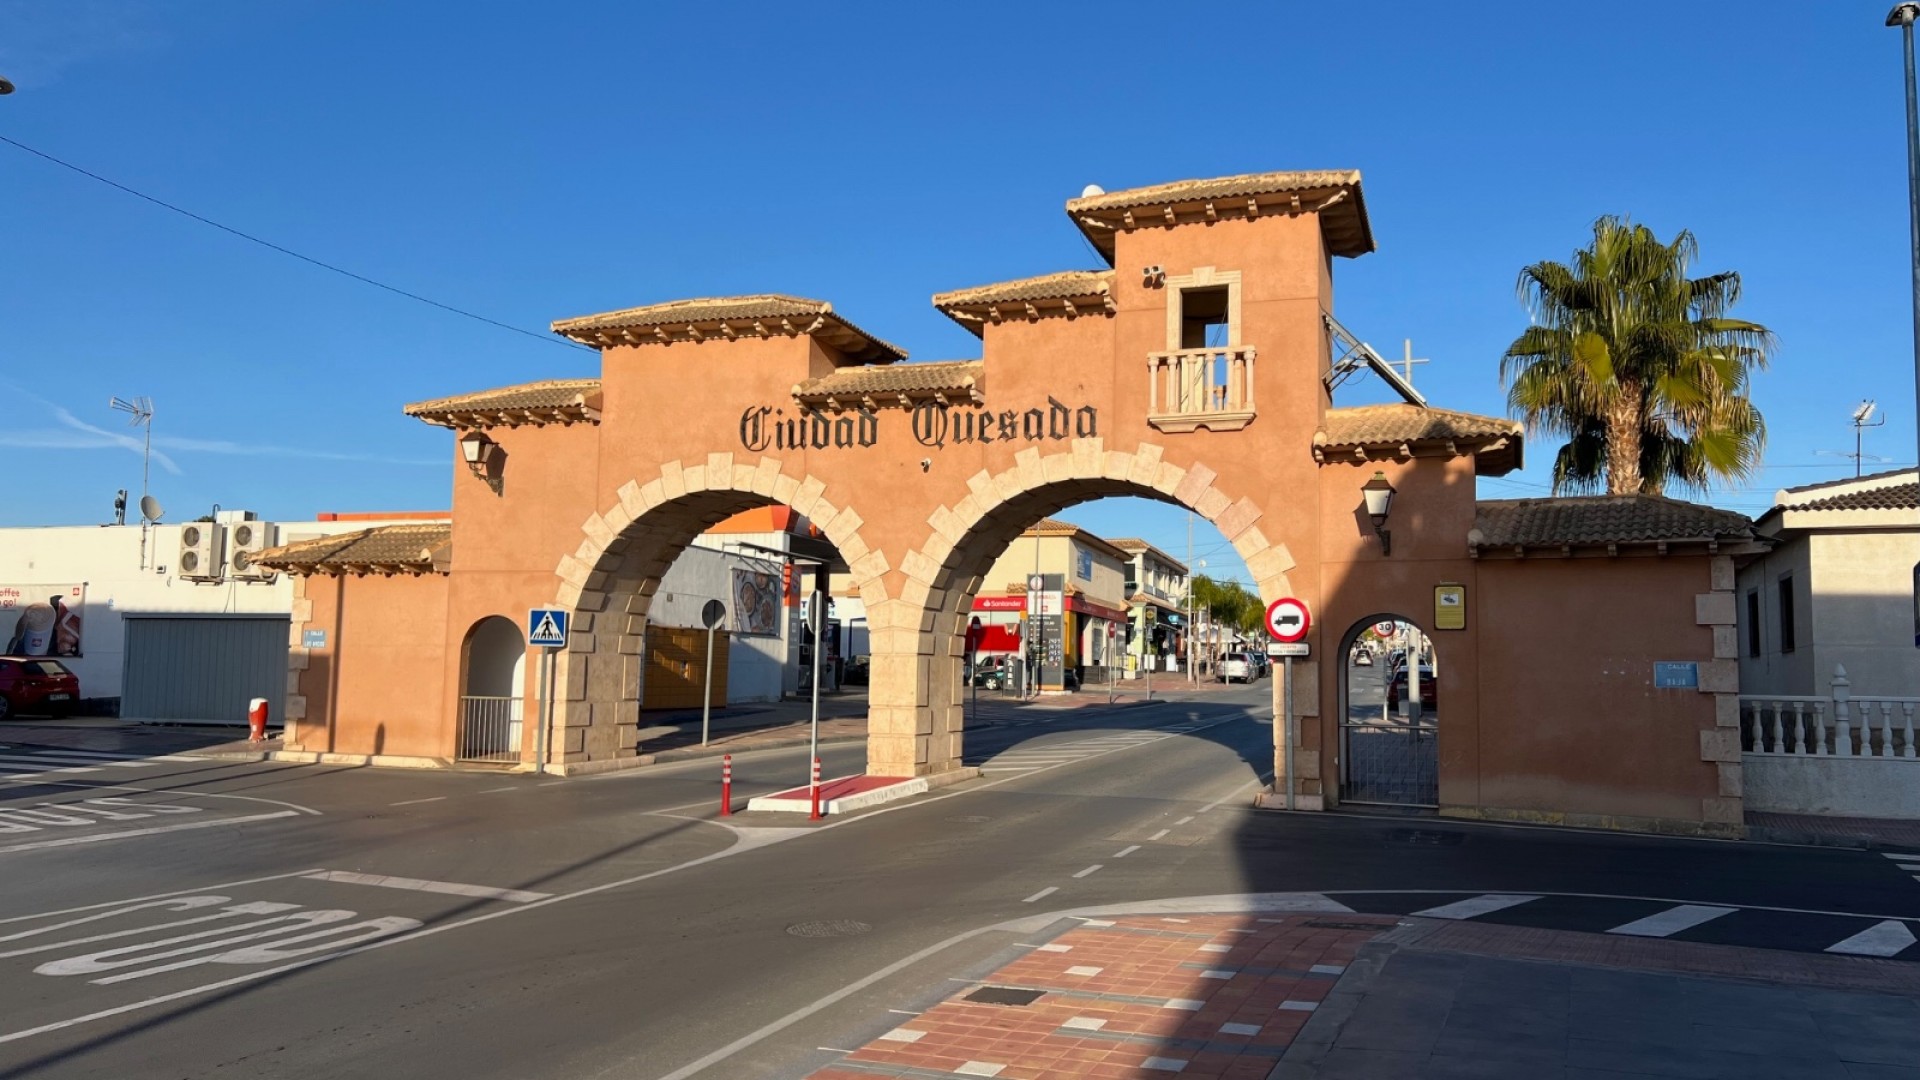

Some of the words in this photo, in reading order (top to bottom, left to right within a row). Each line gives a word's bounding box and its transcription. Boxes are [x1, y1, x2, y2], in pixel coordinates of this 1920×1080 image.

[739, 404, 878, 452] Ciudad
[911, 395, 1098, 451] Quesada
[1378, 623, 1391, 631] 30
